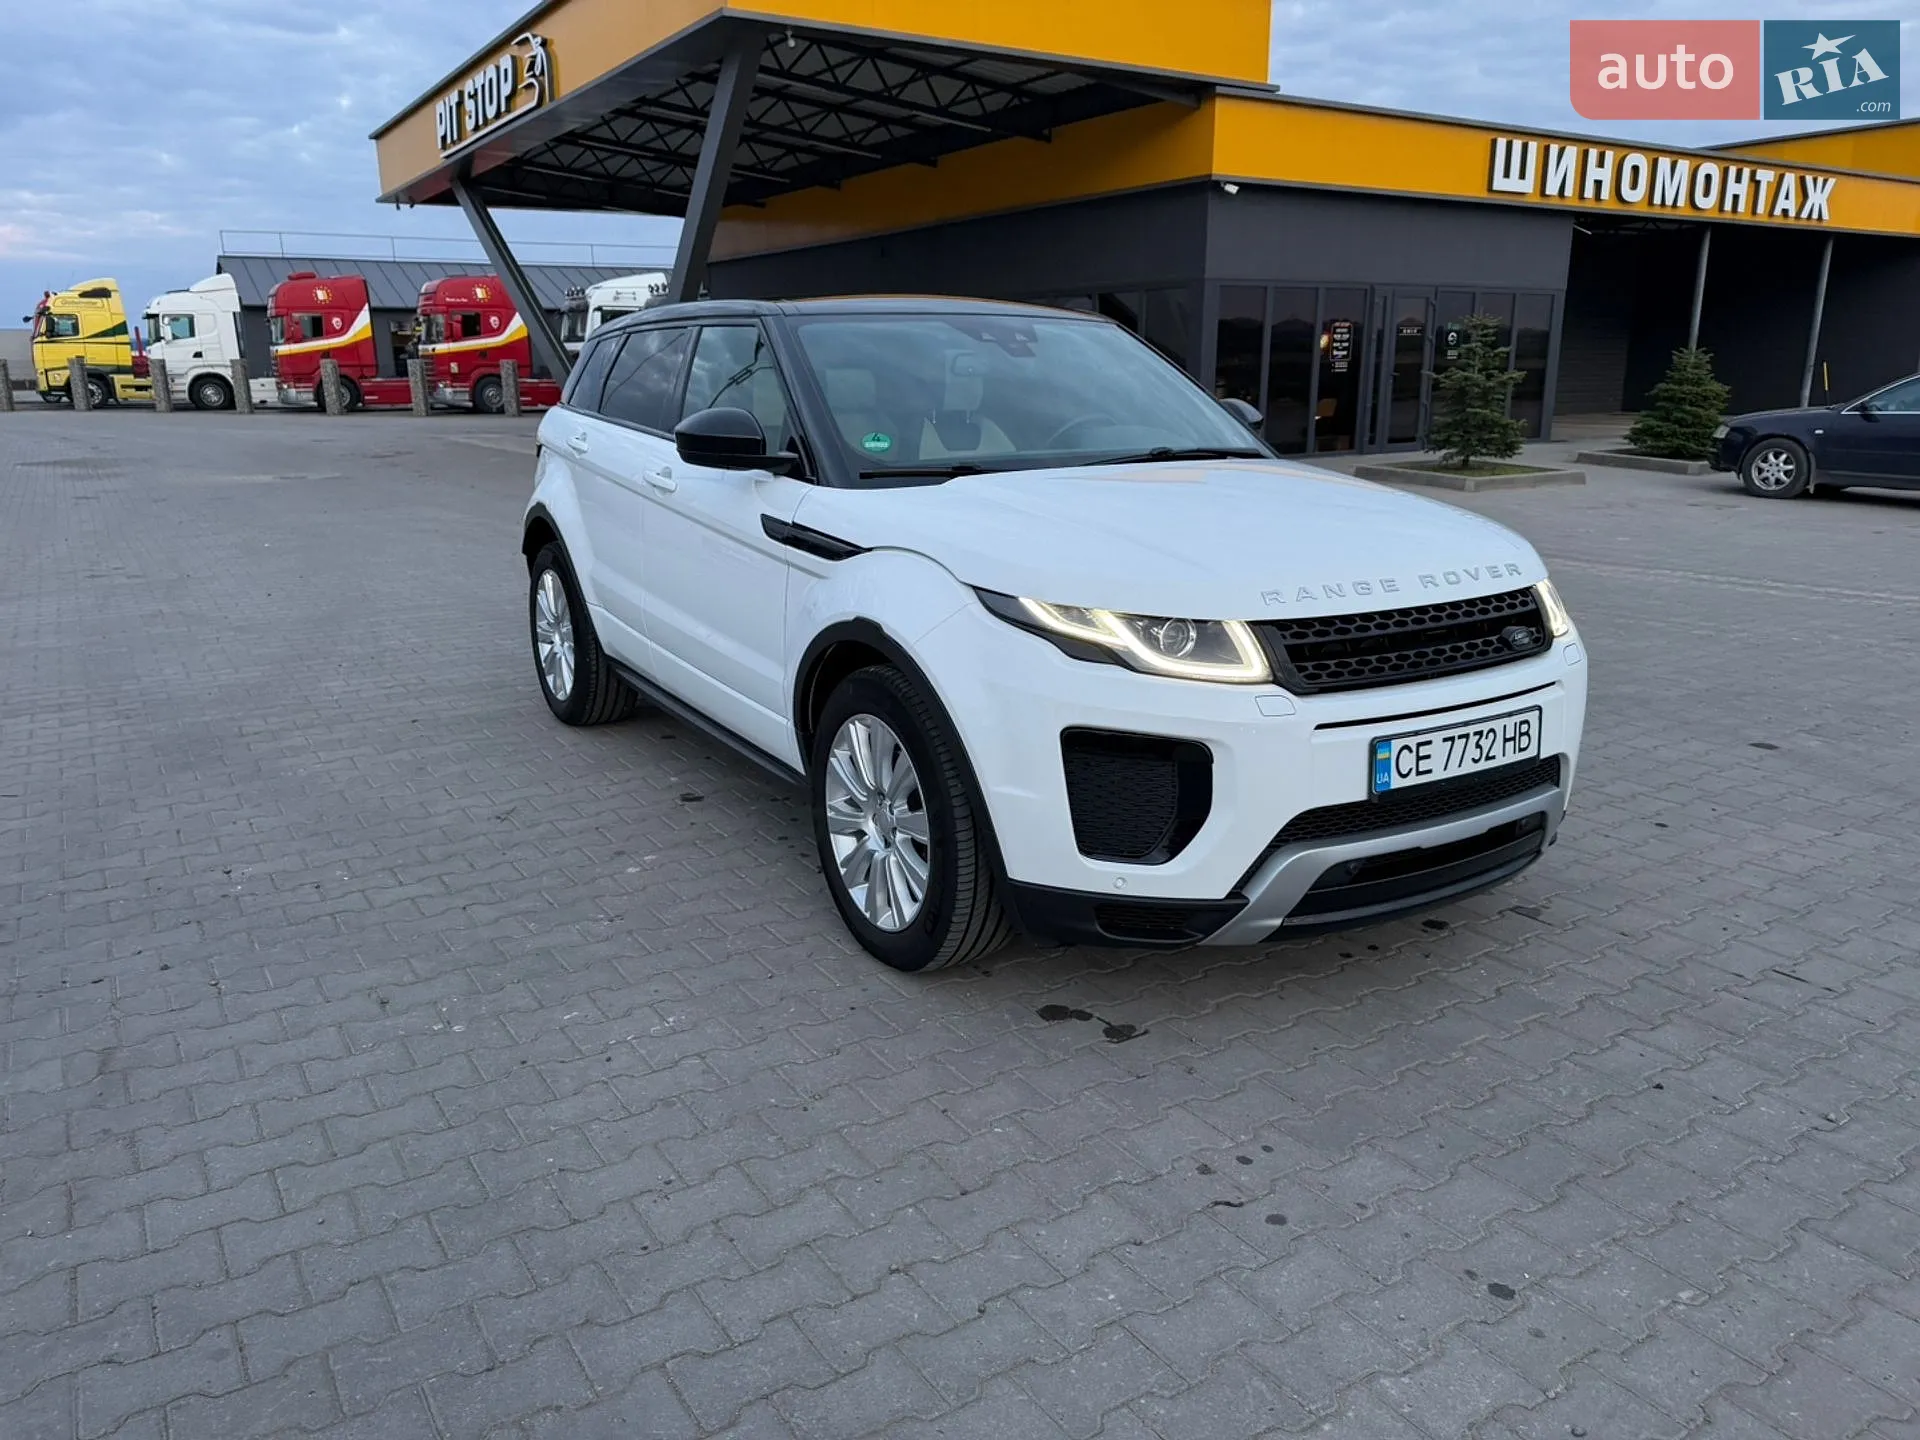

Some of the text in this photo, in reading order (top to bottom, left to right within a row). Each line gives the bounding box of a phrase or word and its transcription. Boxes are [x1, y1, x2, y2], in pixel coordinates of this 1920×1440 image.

[435, 54, 513, 149] PIT STOP
[1491, 137, 1835, 221] ШИНОМОНТАЖ
[1260, 563, 1523, 606] RANGE ROVER
[1376, 772, 1390, 784] UA
[1395, 719, 1532, 779] CE 7732 HB
